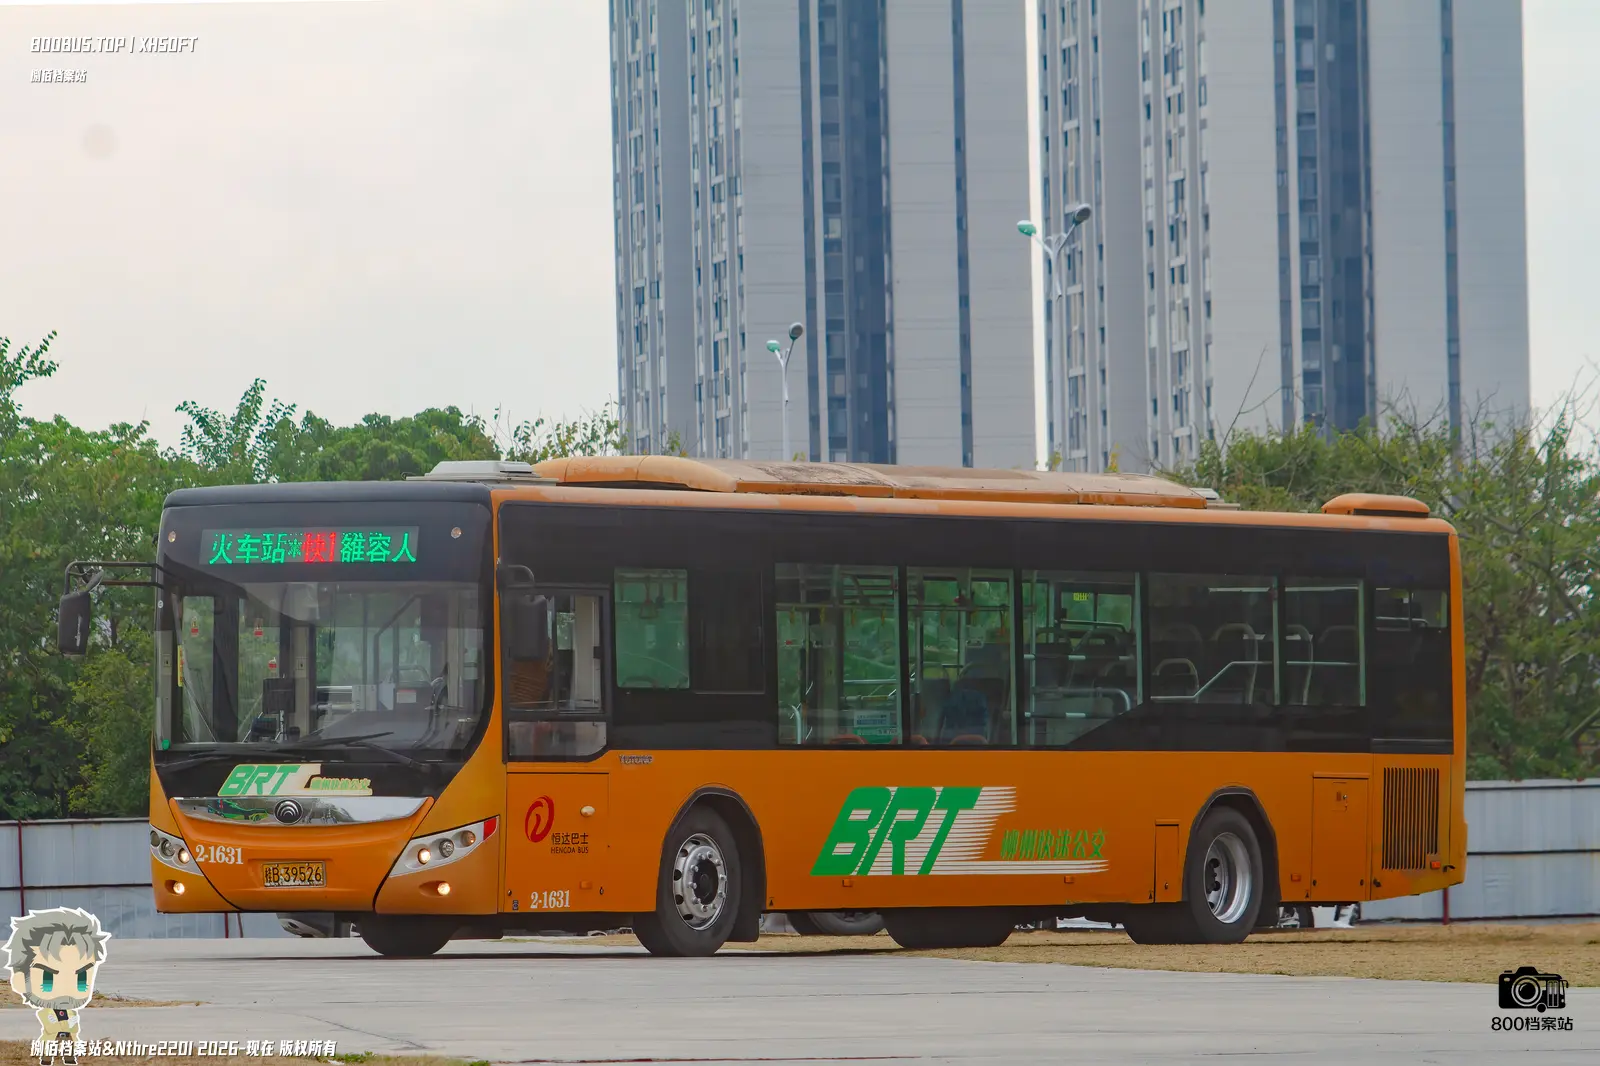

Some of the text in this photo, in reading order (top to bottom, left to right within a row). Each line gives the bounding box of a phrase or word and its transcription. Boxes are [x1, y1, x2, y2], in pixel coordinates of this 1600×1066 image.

[219, 764, 302, 796] BRT
[551, 832, 589, 845] 恒达巴士
[810, 786, 983, 876] BRT
[195, 844, 244, 865] 2-1631
[550, 846, 589, 854] HENGDA BUS
[530, 889, 571, 909] 2-1631
